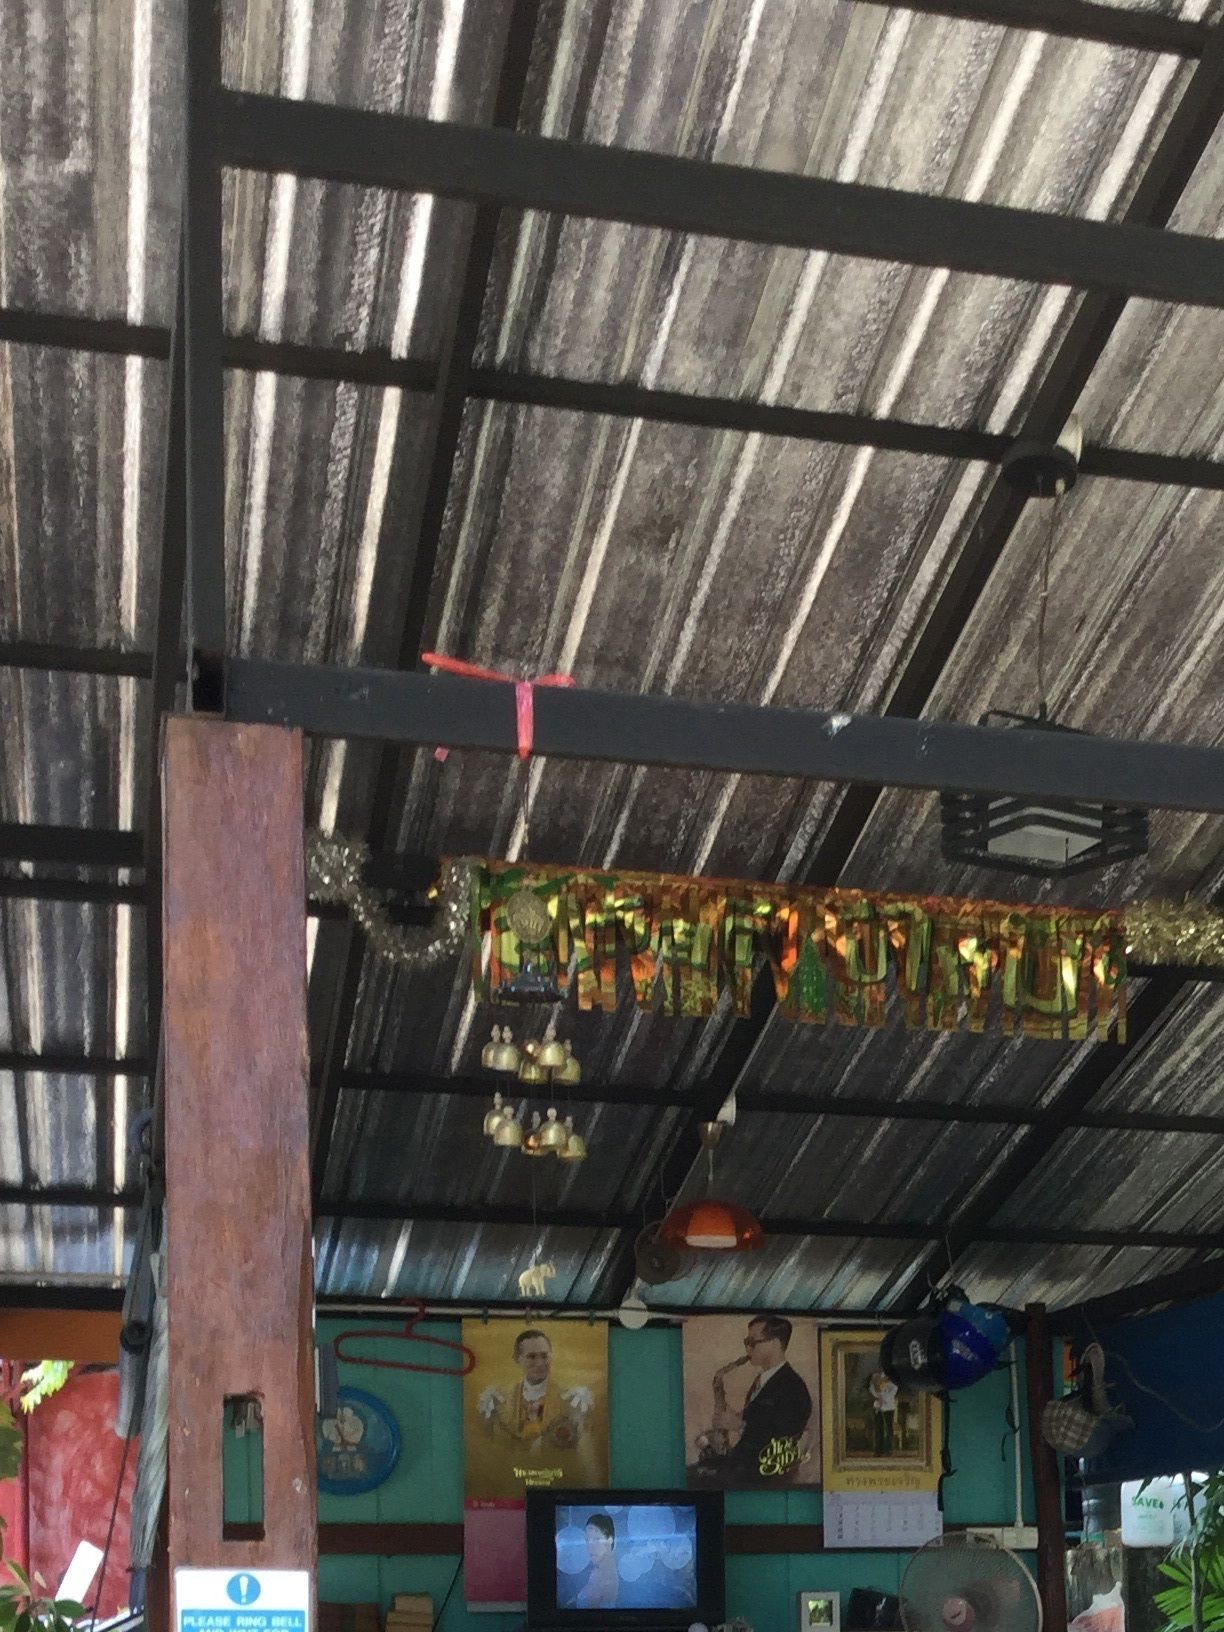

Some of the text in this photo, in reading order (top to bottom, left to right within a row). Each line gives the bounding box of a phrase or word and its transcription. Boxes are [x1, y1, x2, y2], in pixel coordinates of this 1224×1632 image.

[183, 1616, 301, 1627] PLEASE RING BELL
